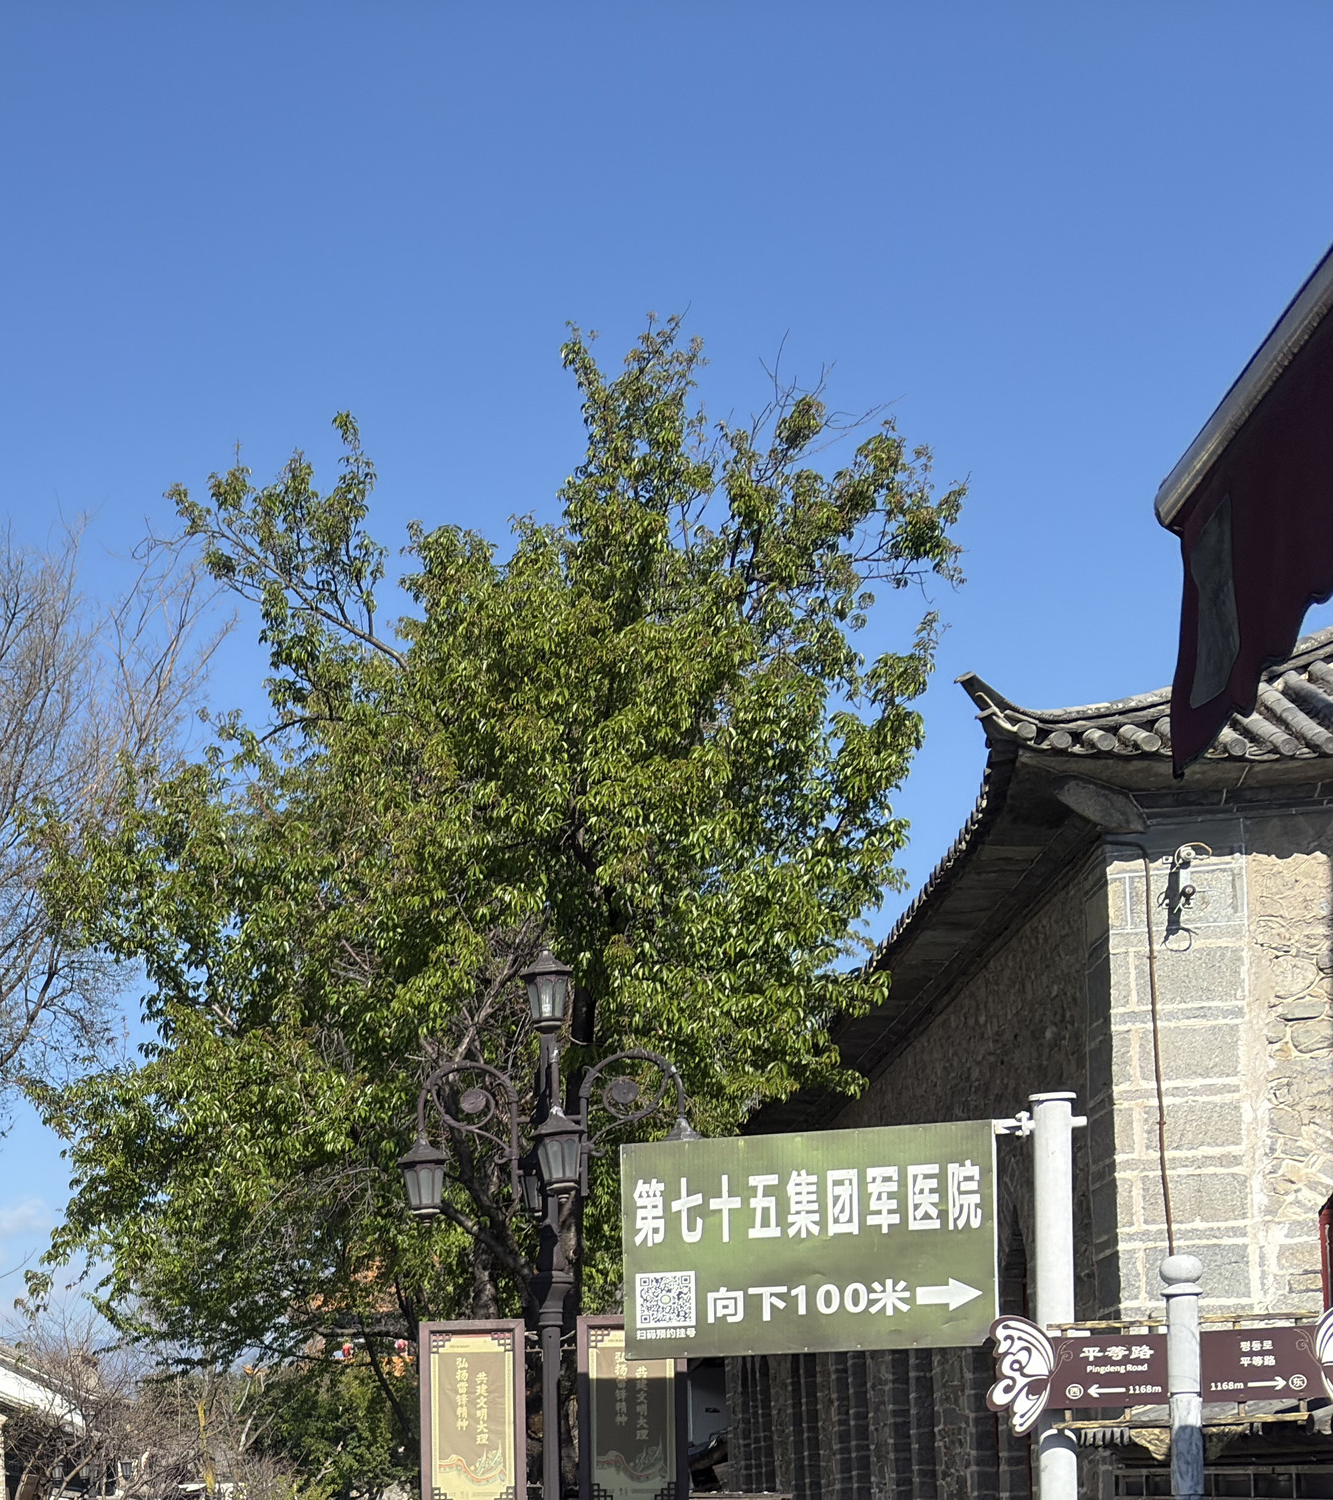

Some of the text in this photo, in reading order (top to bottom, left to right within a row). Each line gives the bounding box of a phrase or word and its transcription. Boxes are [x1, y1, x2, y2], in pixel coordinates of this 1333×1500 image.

[633, 1160, 983, 1247] 第七十五集团军医院
[707, 1278, 910, 1324] 向下100米
[636, 1328, 696, 1340] 扫码预约挂号
[1079, 1344, 1154, 1361] 平等路
[1239, 1355, 1276, 1367] 平等路
[1086, 1363, 1148, 1374] Pingdeng Road
[1128, 1384, 1162, 1394] 1168m
[1210, 1381, 1245, 1391] 1168m
[1292, 1377, 1303, 1388] 东
[456, 1357, 469, 1431] 弘扬雷锋精神
[475, 1371, 489, 1445] 共建文明大理
[635, 1366, 649, 1440] 共建文明大理
